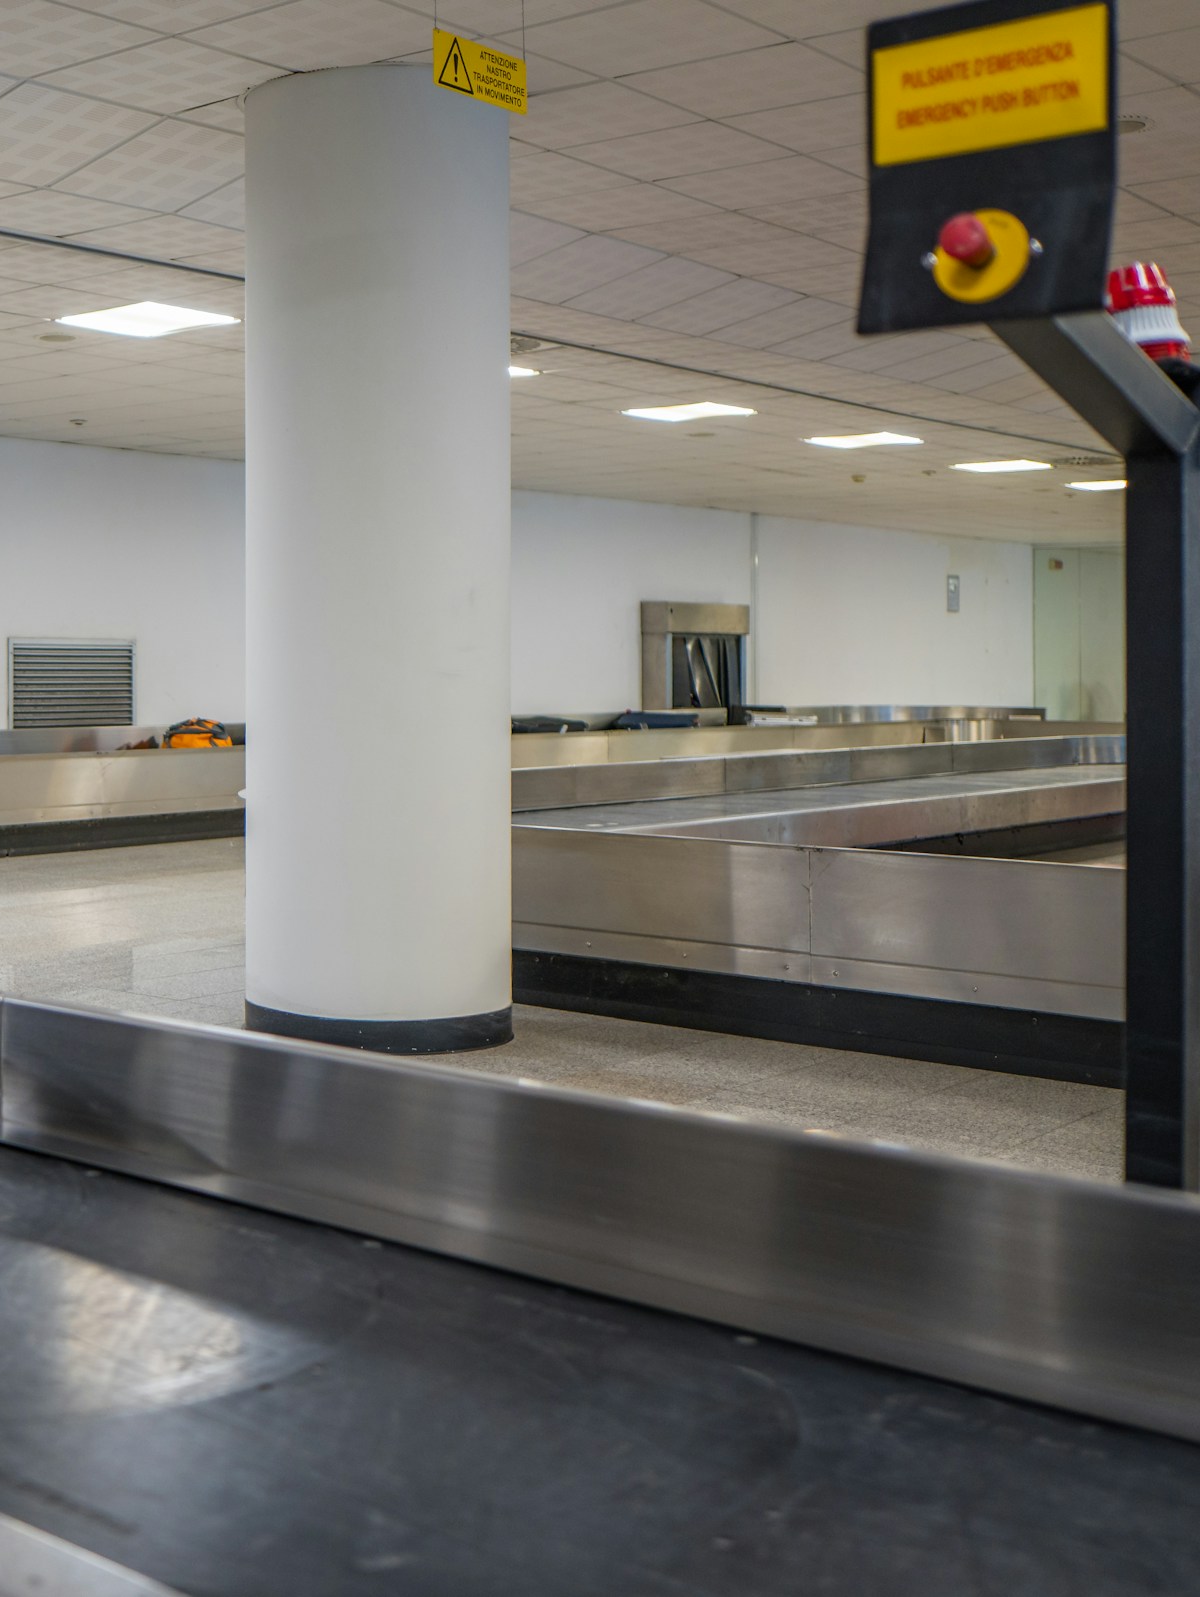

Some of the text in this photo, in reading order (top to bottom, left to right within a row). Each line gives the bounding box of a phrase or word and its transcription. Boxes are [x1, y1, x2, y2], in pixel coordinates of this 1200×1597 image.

[480, 51, 517, 71] ATTENZIONE
[486, 65, 511, 80] NASTRO
[473, 72, 525, 97] TRASPORTATORE
[902, 60, 969, 89] PULSANTE
[476, 84, 522, 107] IN MOVIMENTO
[896, 79, 1080, 130] EMERGENCY PUSH BUTTON
